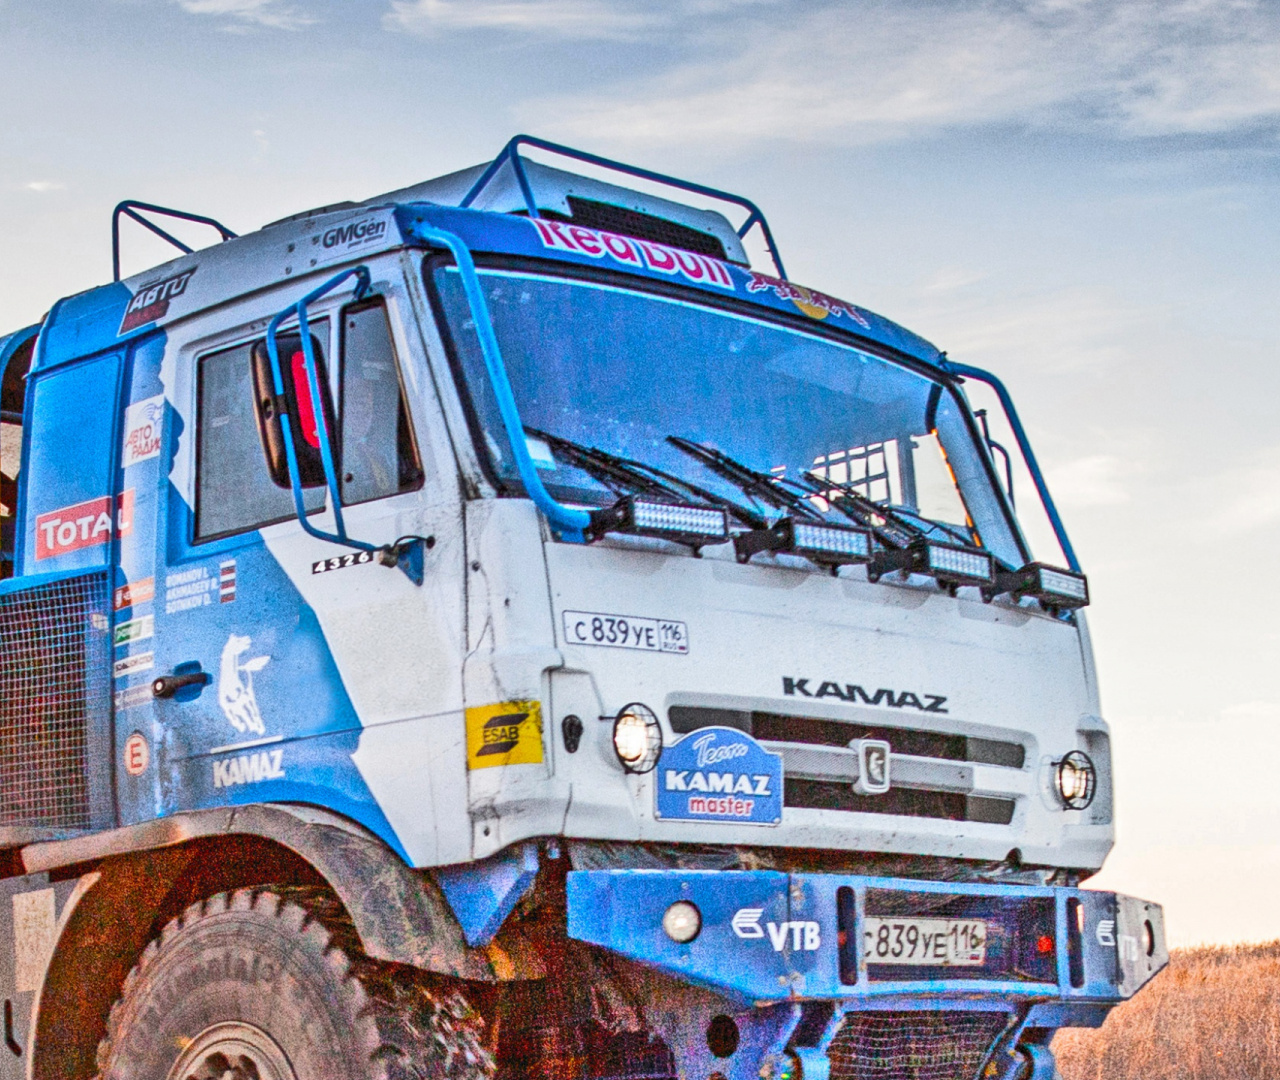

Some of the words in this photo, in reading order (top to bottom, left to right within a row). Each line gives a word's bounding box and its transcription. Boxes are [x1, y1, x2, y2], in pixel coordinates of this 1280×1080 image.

[534, 217, 640, 264] Red
[640, 240, 733, 288] Bull
[40, 508, 130, 550] TOTAL
[314, 551, 370, 573] 4326
[782, 676, 949, 714] KAMAZ
[483, 726, 519, 743] ESAB
[213, 748, 286, 788] KAMAZ
[665, 770, 772, 796] KAMAZ
[689, 796, 754, 816] master
[767, 920, 820, 953] VTB
[950, 923, 979, 950] 116
